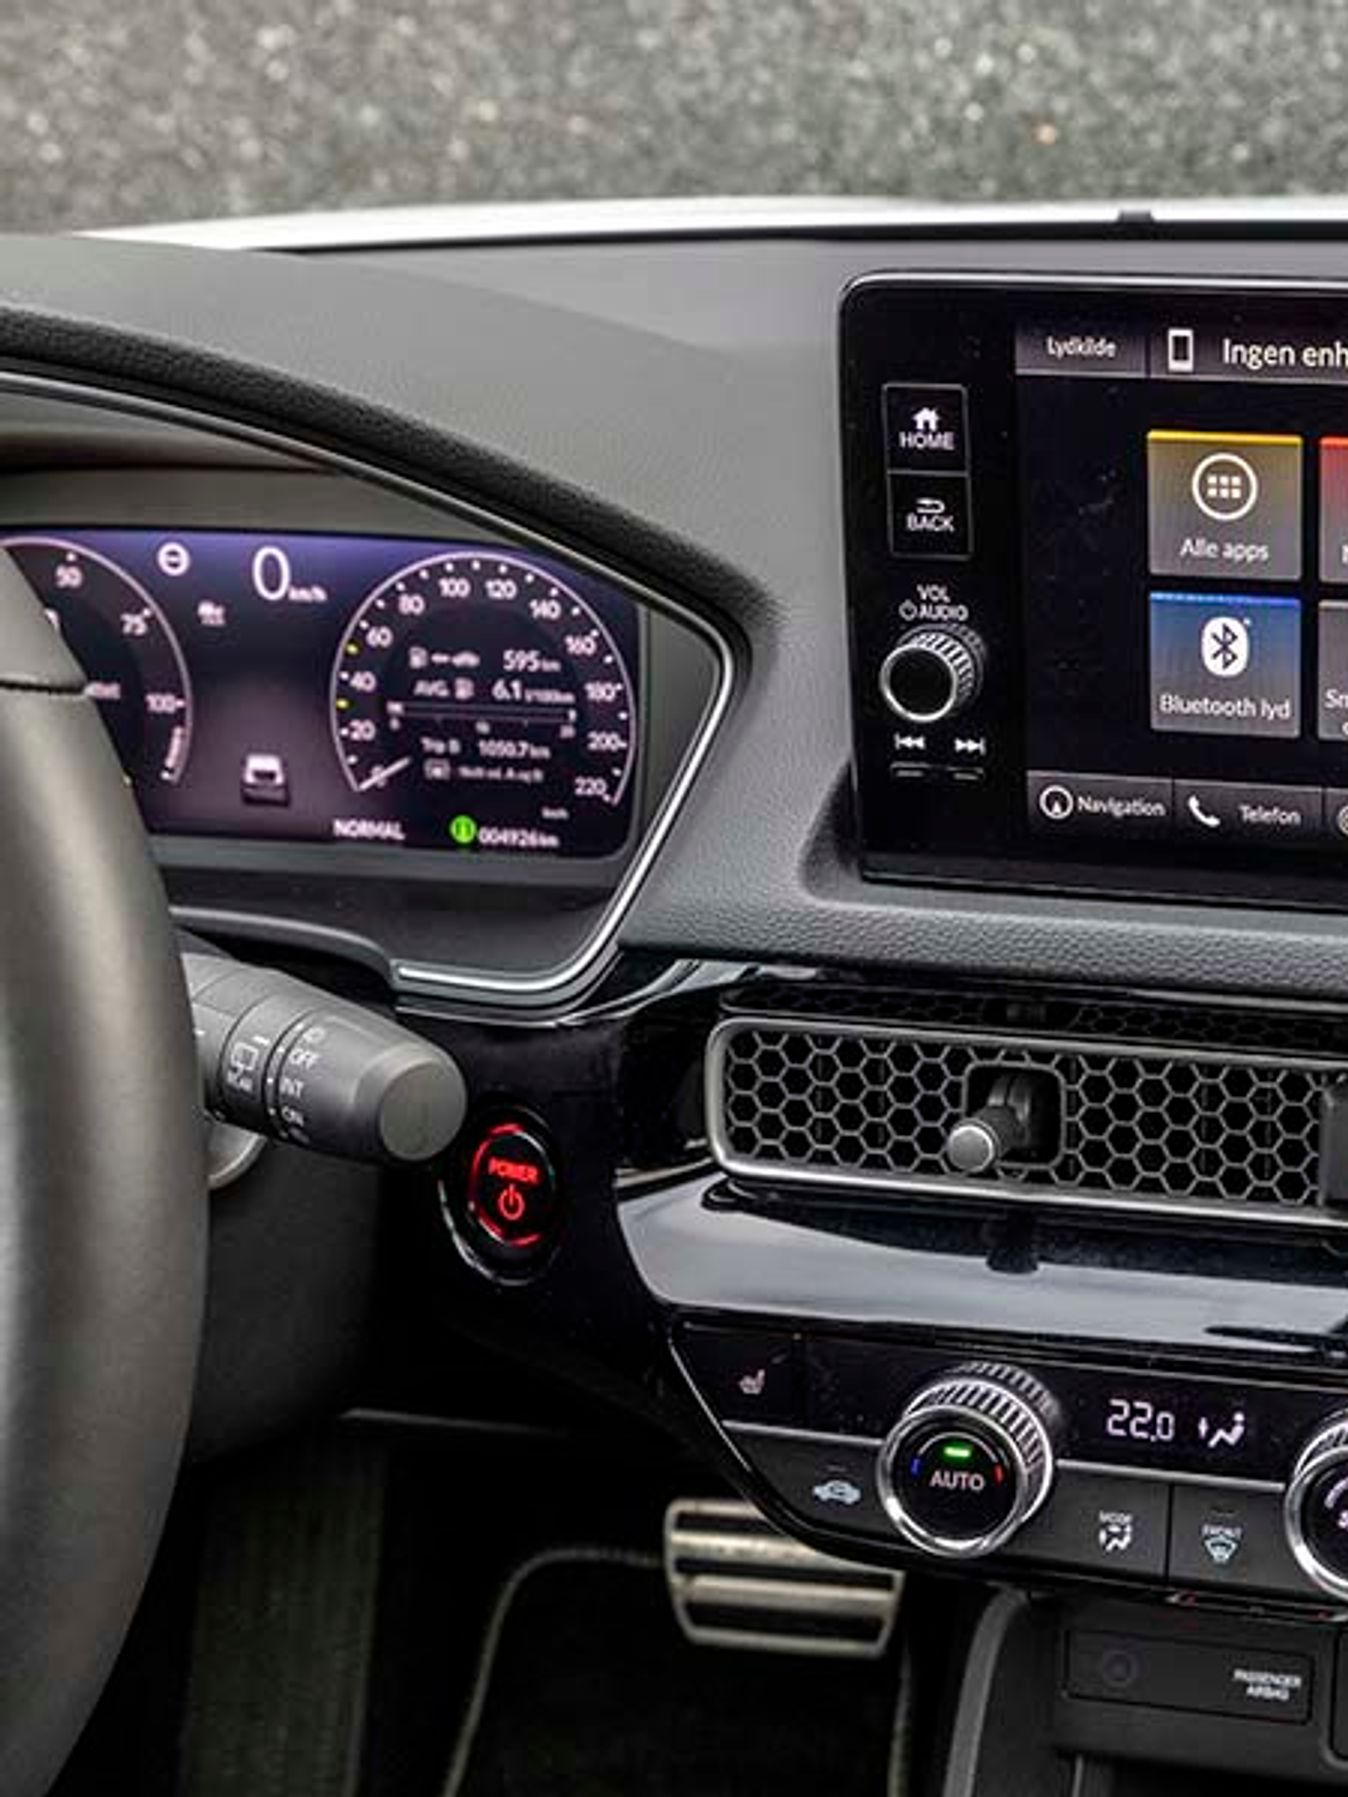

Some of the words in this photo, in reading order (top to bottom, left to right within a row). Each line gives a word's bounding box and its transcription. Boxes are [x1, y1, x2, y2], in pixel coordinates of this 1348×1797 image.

[1046, 338, 1118, 361] Lydkilde
[1223, 339, 1295, 368] Ingen
[900, 431, 956, 451] HOME
[905, 512, 955, 533] BACK
[1179, 537, 1217, 559] Alle
[1222, 542, 1270, 564] apps
[55, 565, 83, 588] 50
[252, 545, 291, 601] 0
[437, 577, 471, 599] 100
[484, 578, 518, 600] 120
[917, 585, 950, 603] VOL
[398, 594, 426, 616] 80
[529, 599, 563, 620] 140
[918, 602, 969, 621] AUDIO
[120, 613, 148, 636] 75
[366, 626, 394, 648] 60
[564, 634, 597, 656] 160
[502, 649, 540, 673] 595
[349, 671, 377, 693] 40
[584, 681, 616, 703] 180
[146, 692, 177, 715] 100
[1159, 693, 1258, 719] Bluetooth
[1260, 697, 1291, 723] lyd
[349, 719, 377, 742] 20
[586, 730, 620, 752] 200
[573, 777, 607, 798] 220
[1077, 795, 1167, 819] Navigation
[1239, 804, 1301, 826] Telefon
[332, 819, 406, 841] NORMAL
[488, 1156, 541, 1185] POWER
[1105, 1399, 1176, 1443] 22.0
[930, 1469, 986, 1493] AUTO
